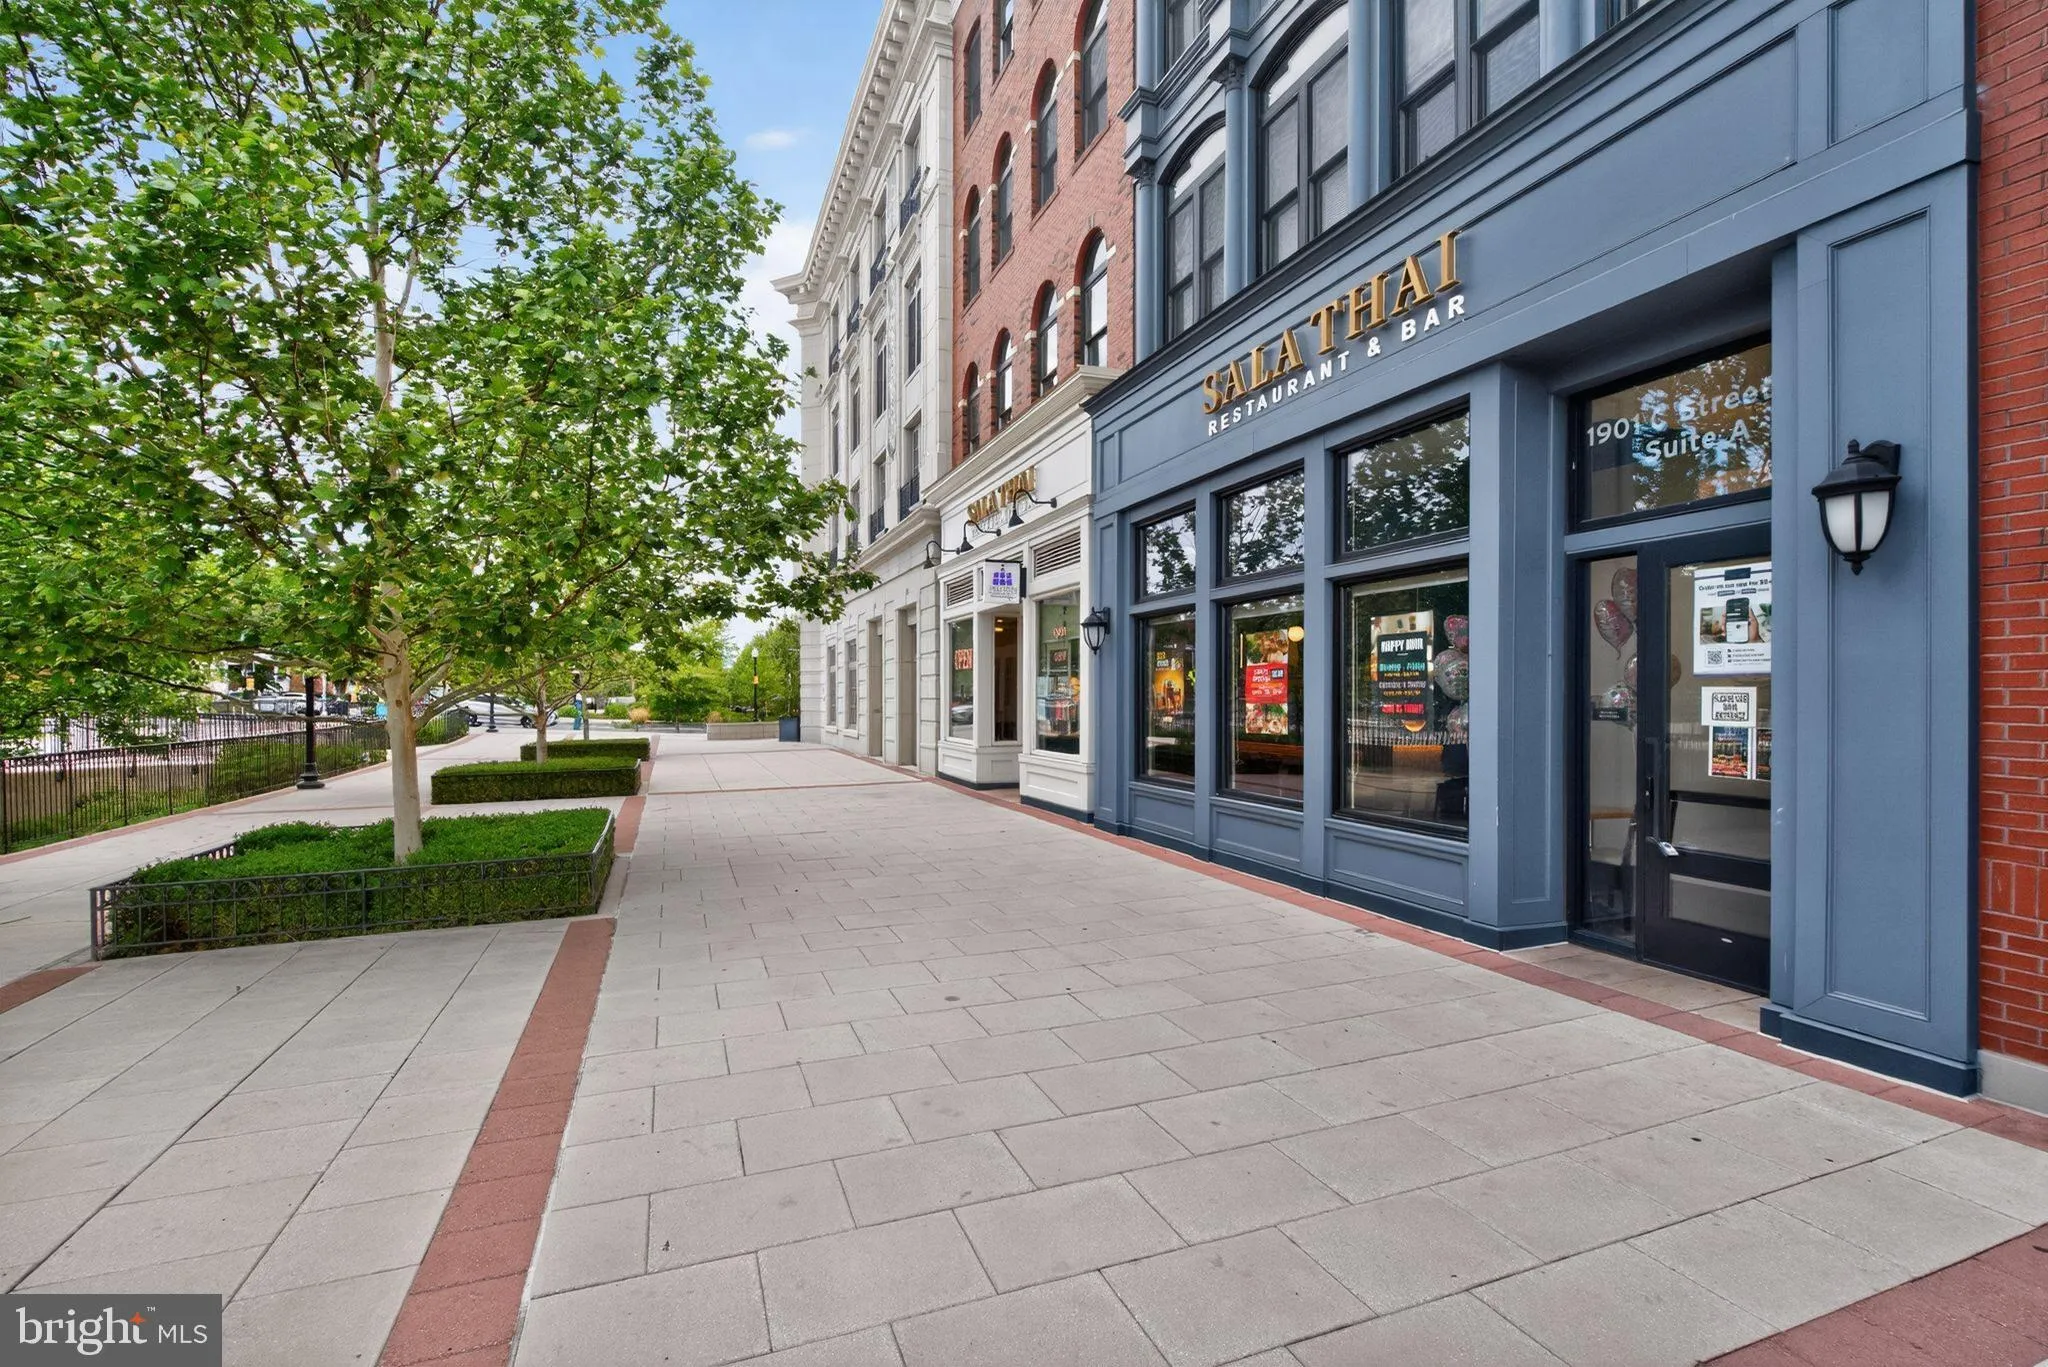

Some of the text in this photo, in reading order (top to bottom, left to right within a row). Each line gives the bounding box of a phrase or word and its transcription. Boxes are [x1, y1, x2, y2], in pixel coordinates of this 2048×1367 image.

[1203, 230, 1462, 415] SALA THAI
[1208, 294, 1466, 437] RESTAURANT & BAR
[1645, 418, 1750, 461] Suite A
